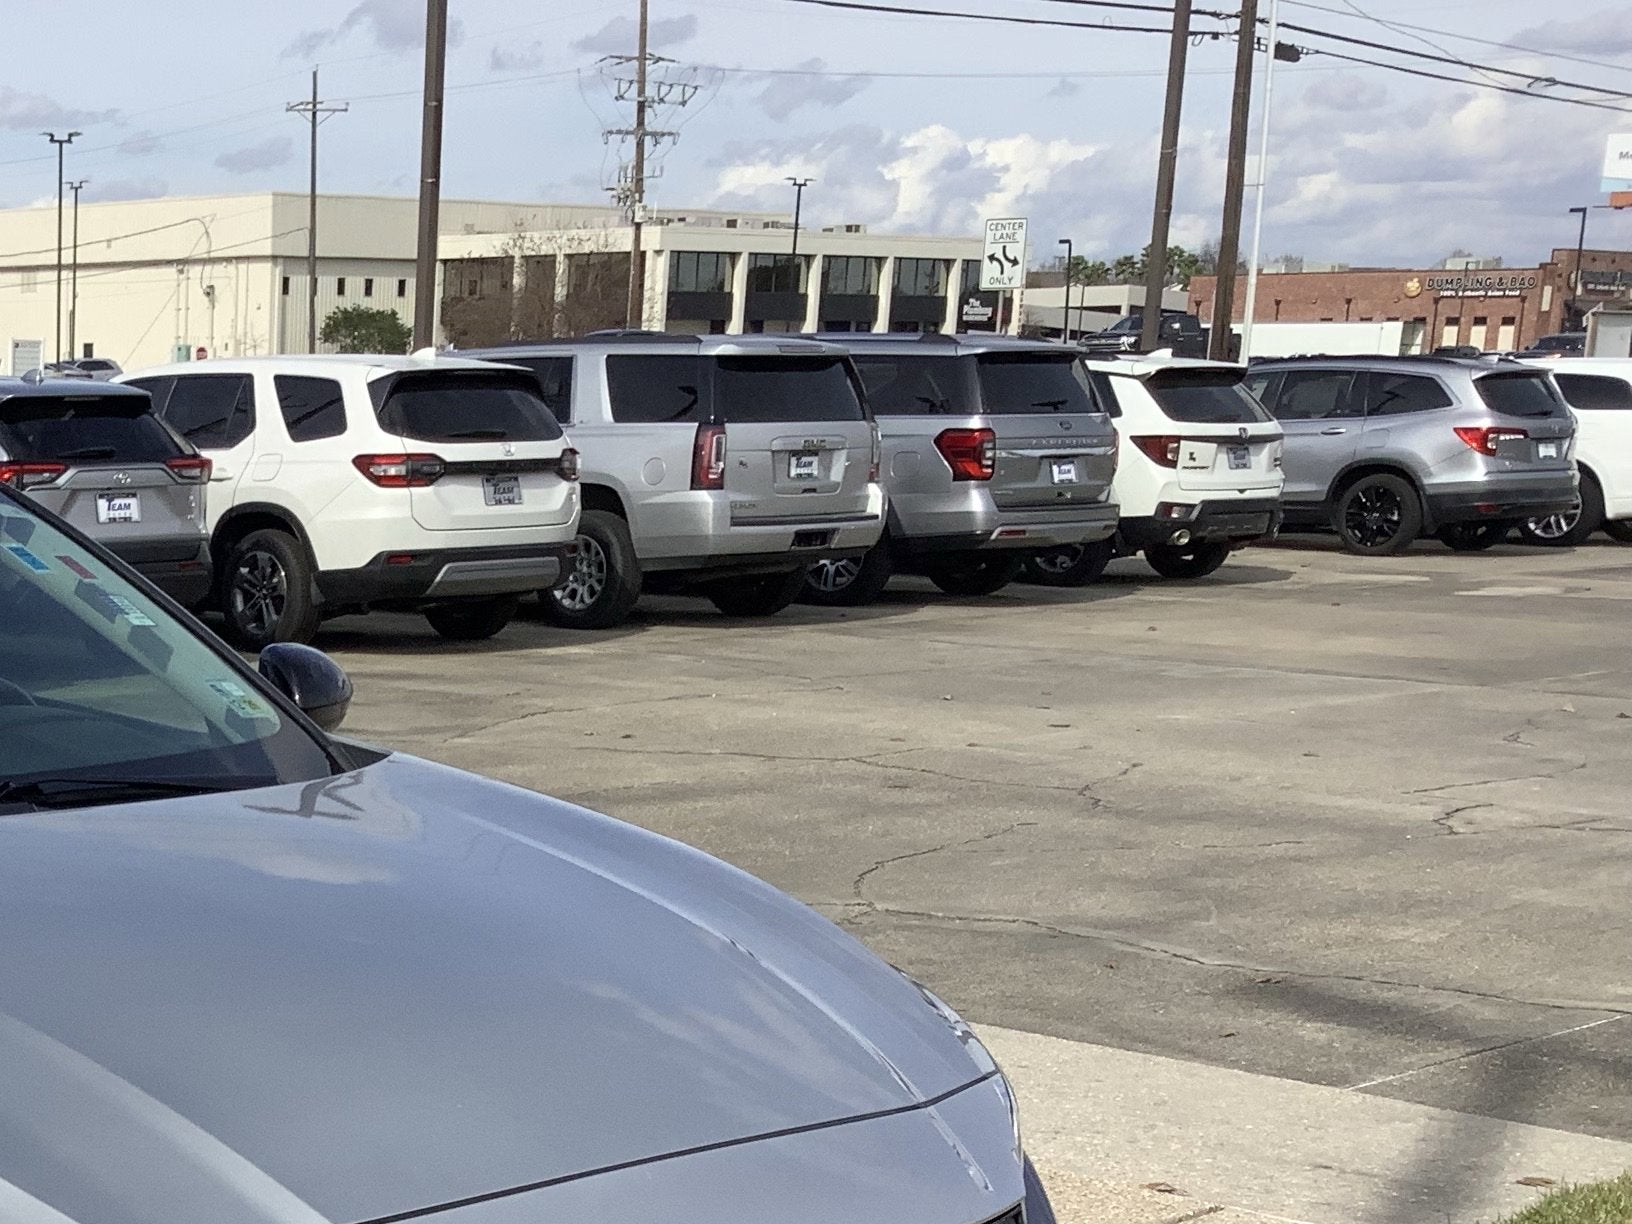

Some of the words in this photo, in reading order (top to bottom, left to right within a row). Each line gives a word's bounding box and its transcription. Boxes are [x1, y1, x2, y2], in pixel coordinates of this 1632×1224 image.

[988, 221, 1024, 232] CENTER
[993, 232, 1018, 241] LANE
[988, 276, 1014, 286] ONLY
[1496, 276, 1505, 289] &
[1508, 276, 1538, 288] BAO
[106, 496, 131, 511] TEAM
